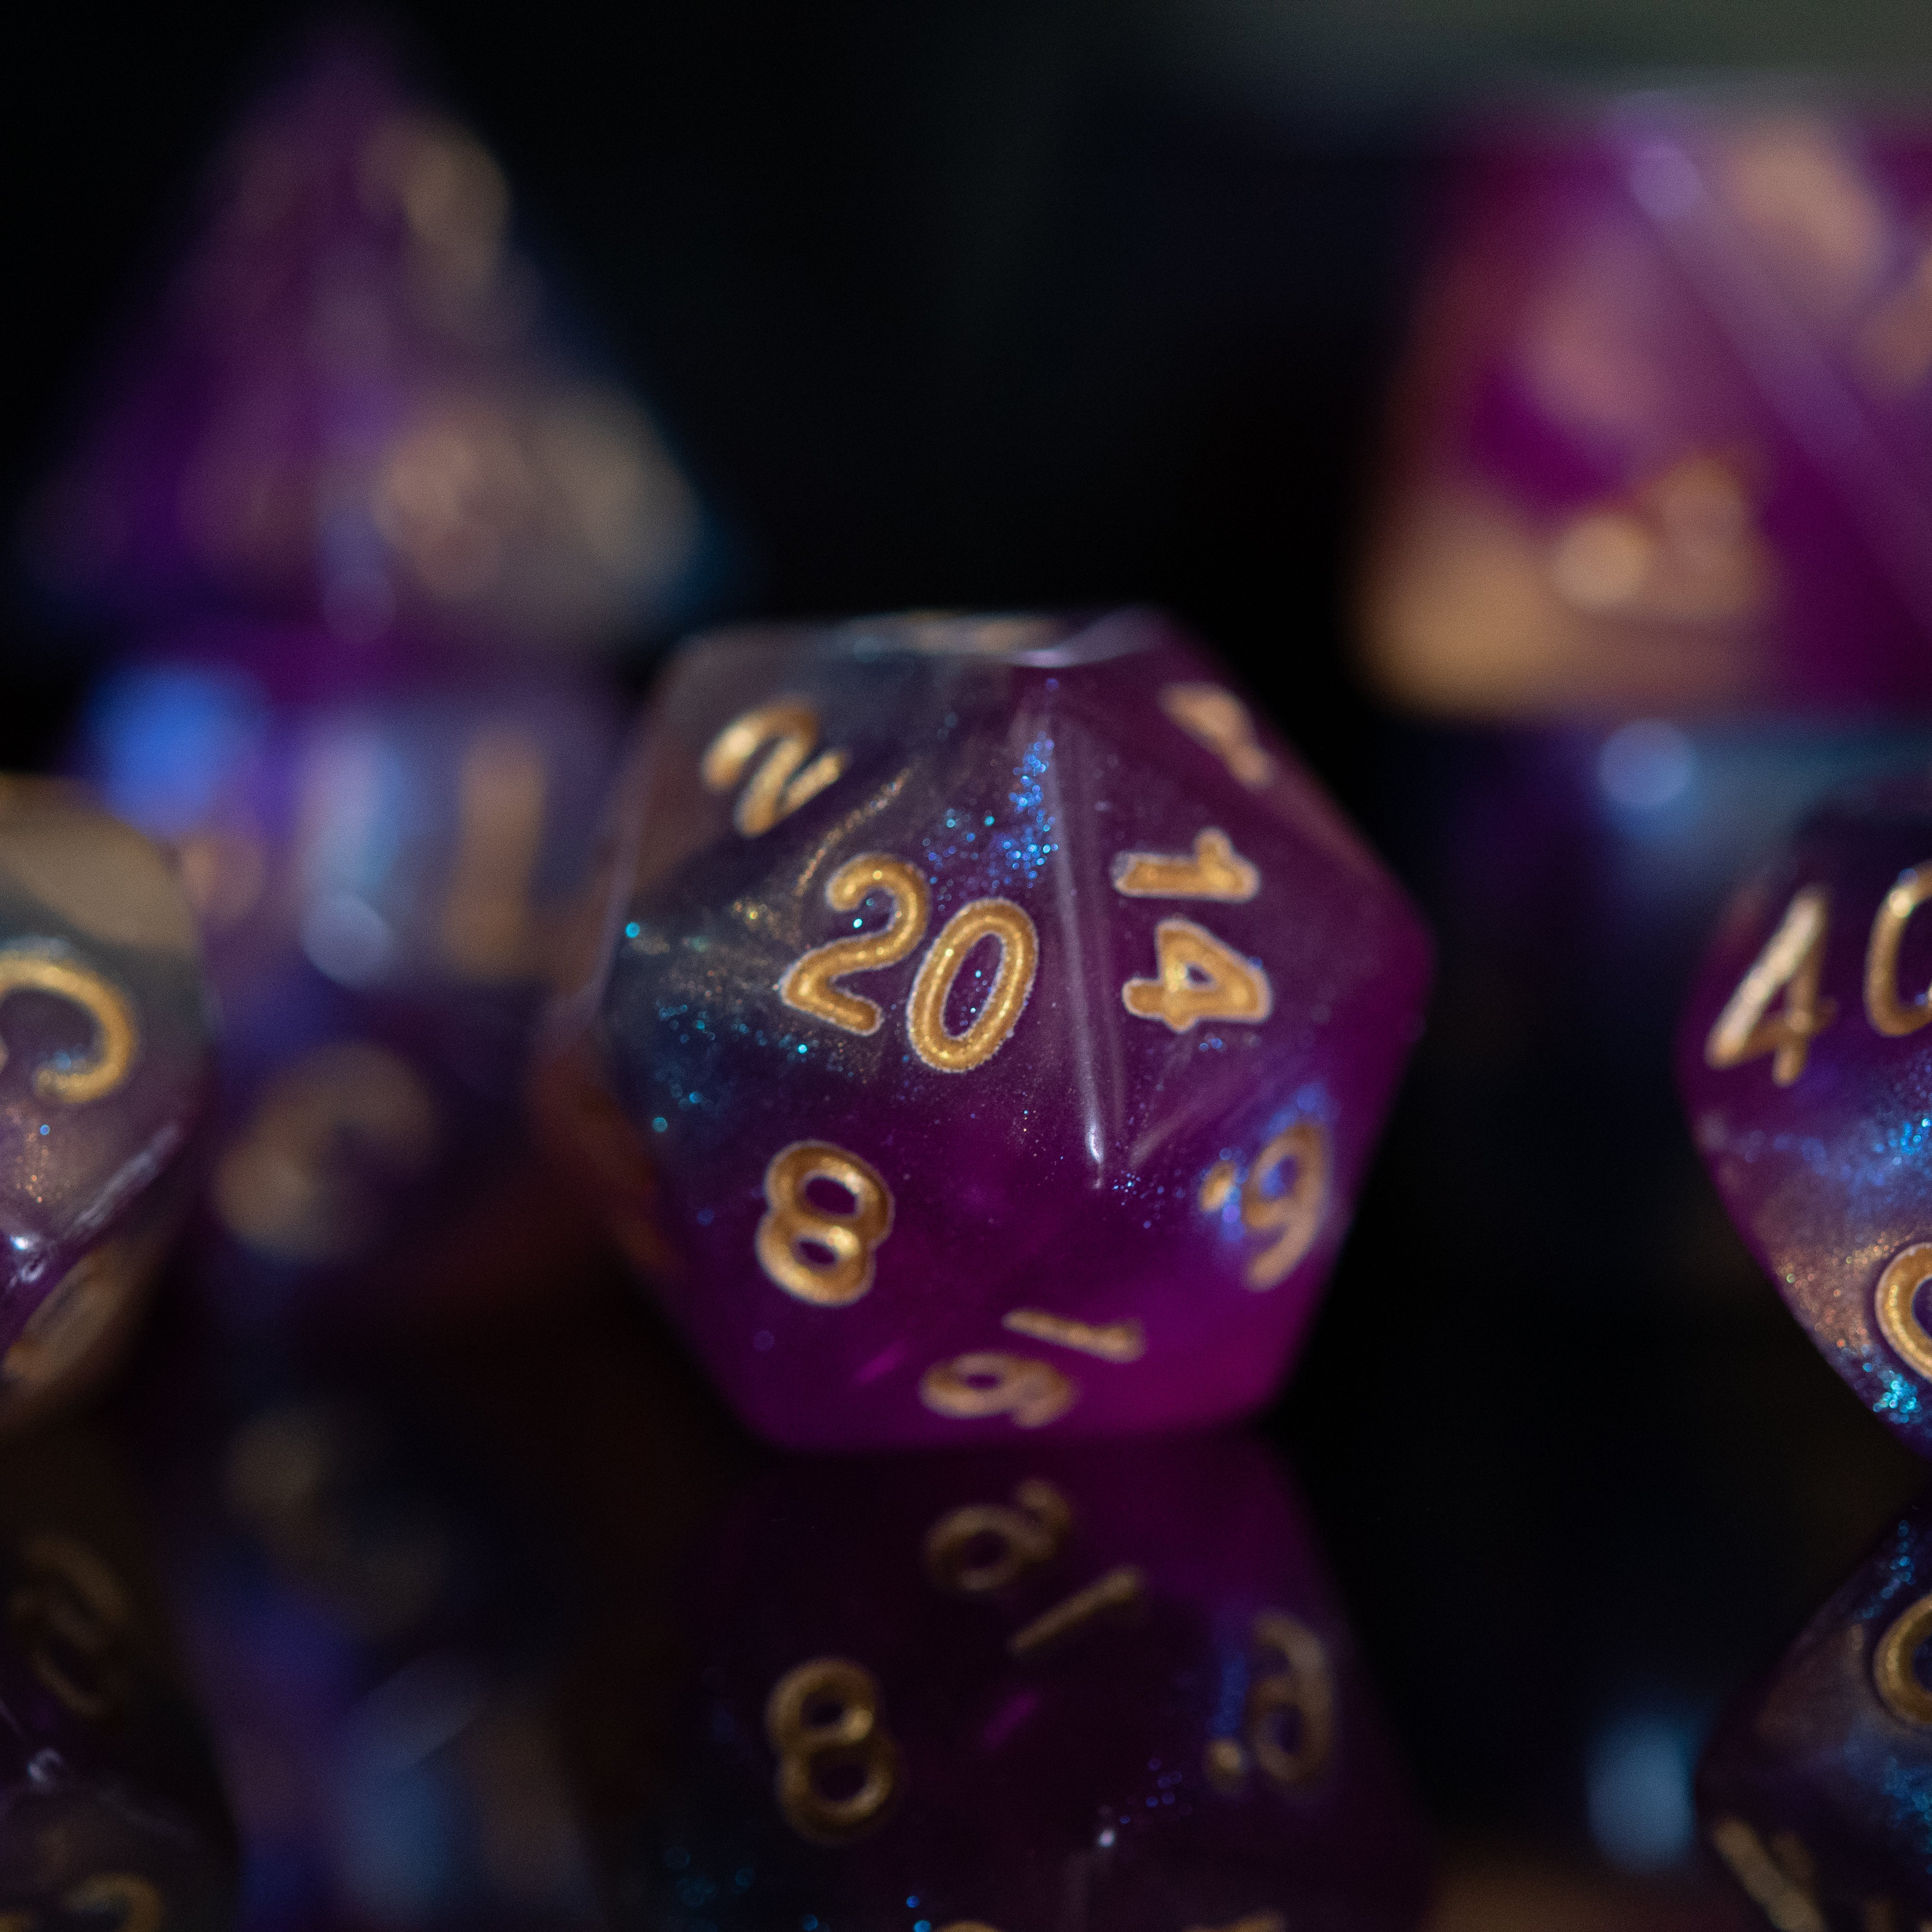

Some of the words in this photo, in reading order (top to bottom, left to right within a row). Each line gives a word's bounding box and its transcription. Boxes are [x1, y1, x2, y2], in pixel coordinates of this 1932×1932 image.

[780, 852, 1038, 1073] 20
[1113, 828, 1272, 1033] 14
[756, 1140, 895, 1306] 8
